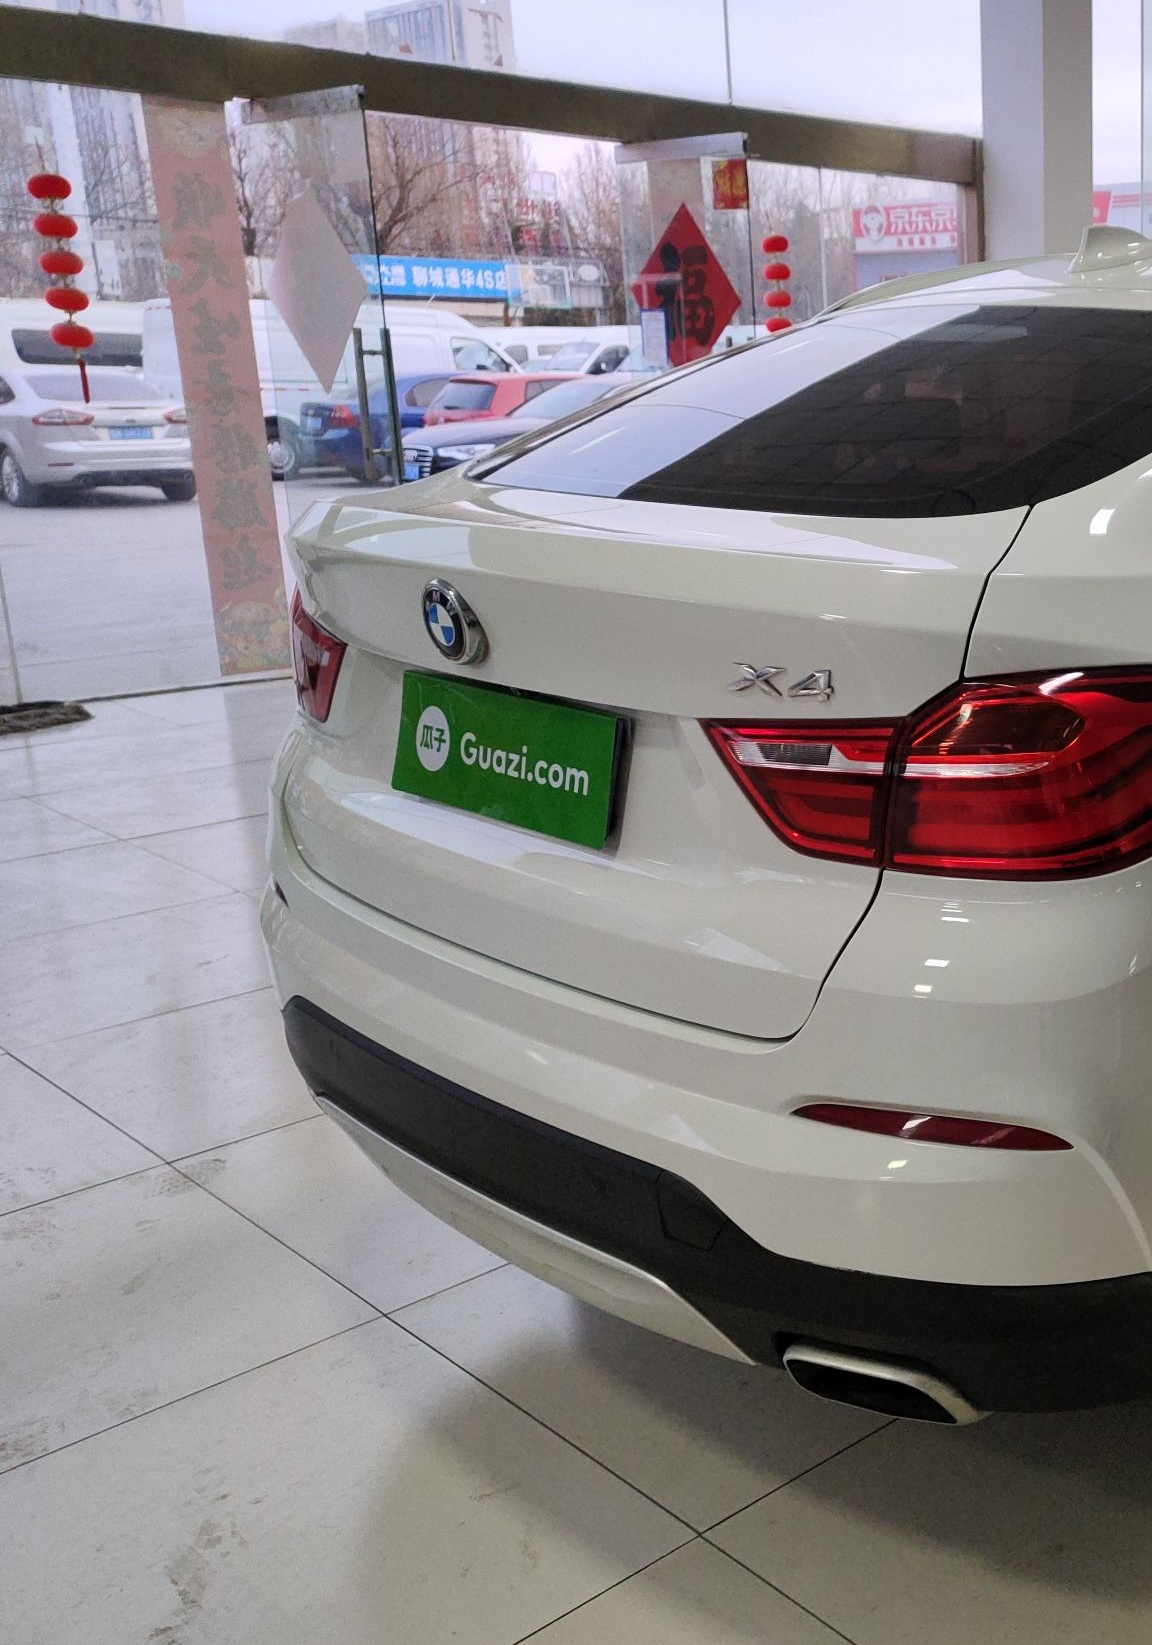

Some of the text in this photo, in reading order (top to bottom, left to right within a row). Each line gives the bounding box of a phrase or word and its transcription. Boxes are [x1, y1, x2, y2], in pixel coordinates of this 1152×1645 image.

[888, 205, 958, 235] 京东京
[725, 662, 834, 701] X4
[420, 724, 447, 752] 瓜子
[460, 731, 589, 796] Guazi.com
